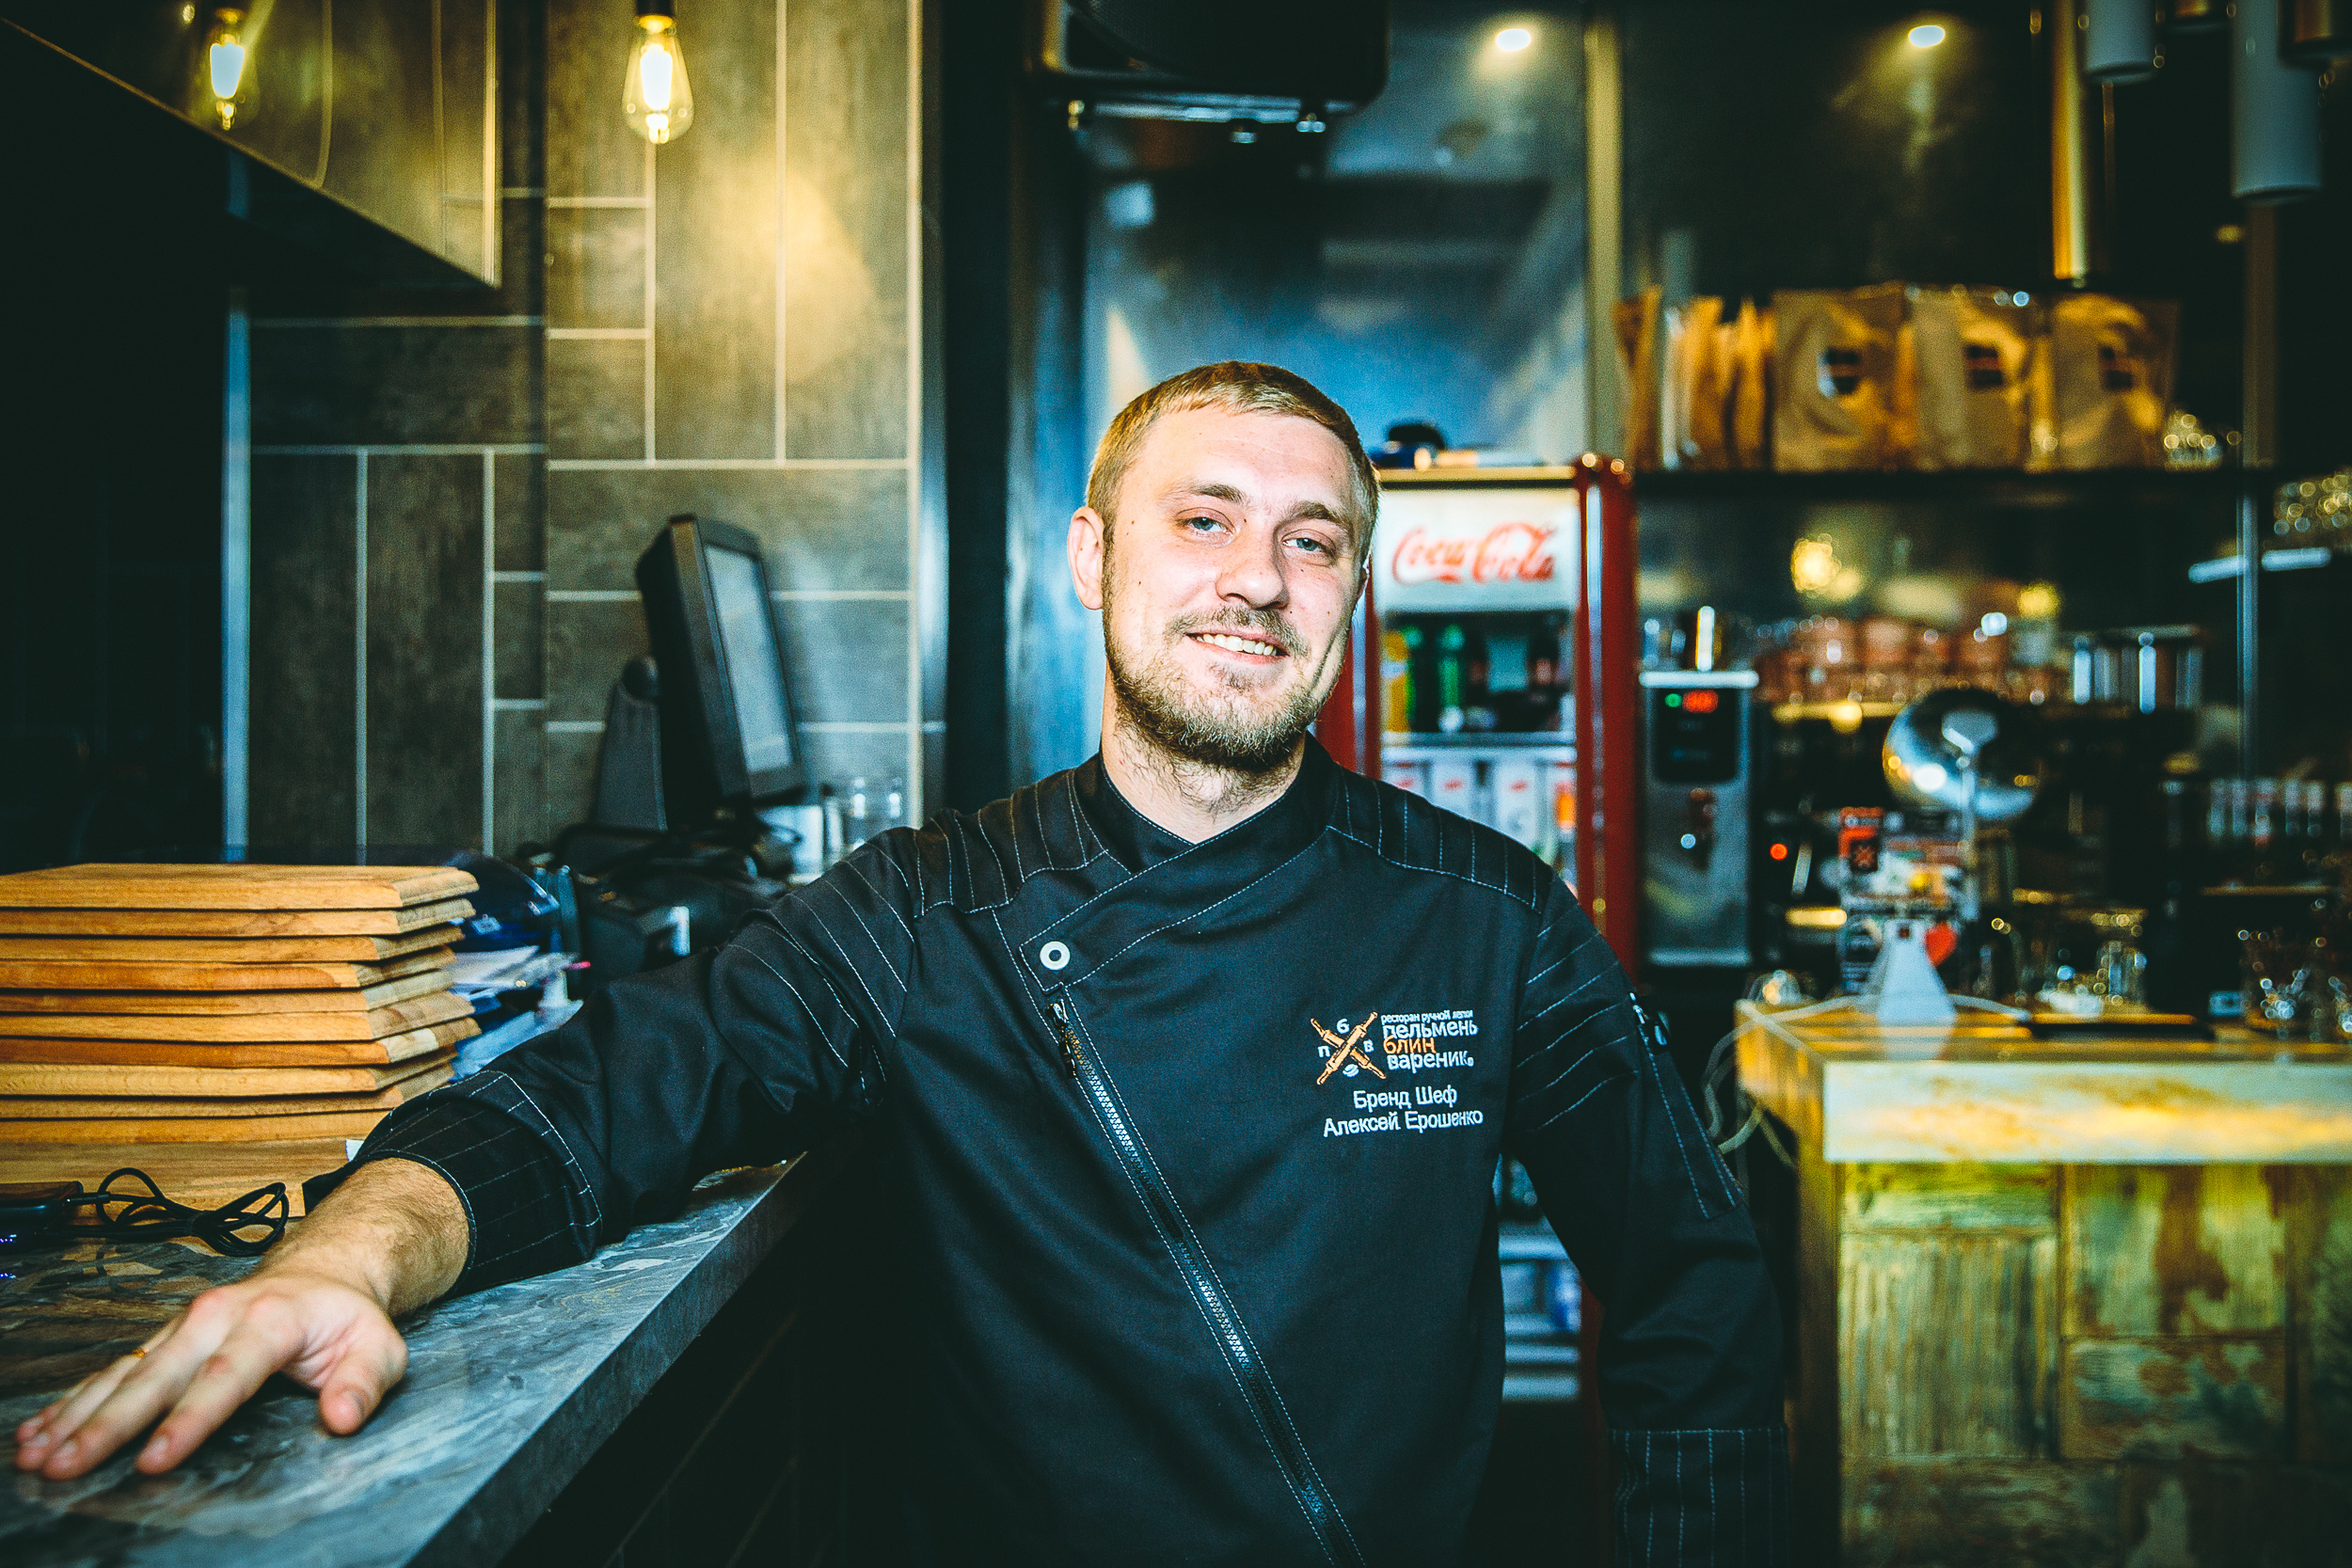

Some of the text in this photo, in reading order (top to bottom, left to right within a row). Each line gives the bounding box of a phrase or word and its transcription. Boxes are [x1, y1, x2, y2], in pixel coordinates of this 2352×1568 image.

[1380, 1013, 1421, 1025] ресторан
[1422, 1009, 1452, 1023] ручной
[1382, 1020, 1480, 1039] пельмень
[1383, 1034, 1438, 1054] блин
[1353, 1085, 1458, 1113] Бренд Шеф
[1323, 1110, 1484, 1138] Алексей Ерошенко
